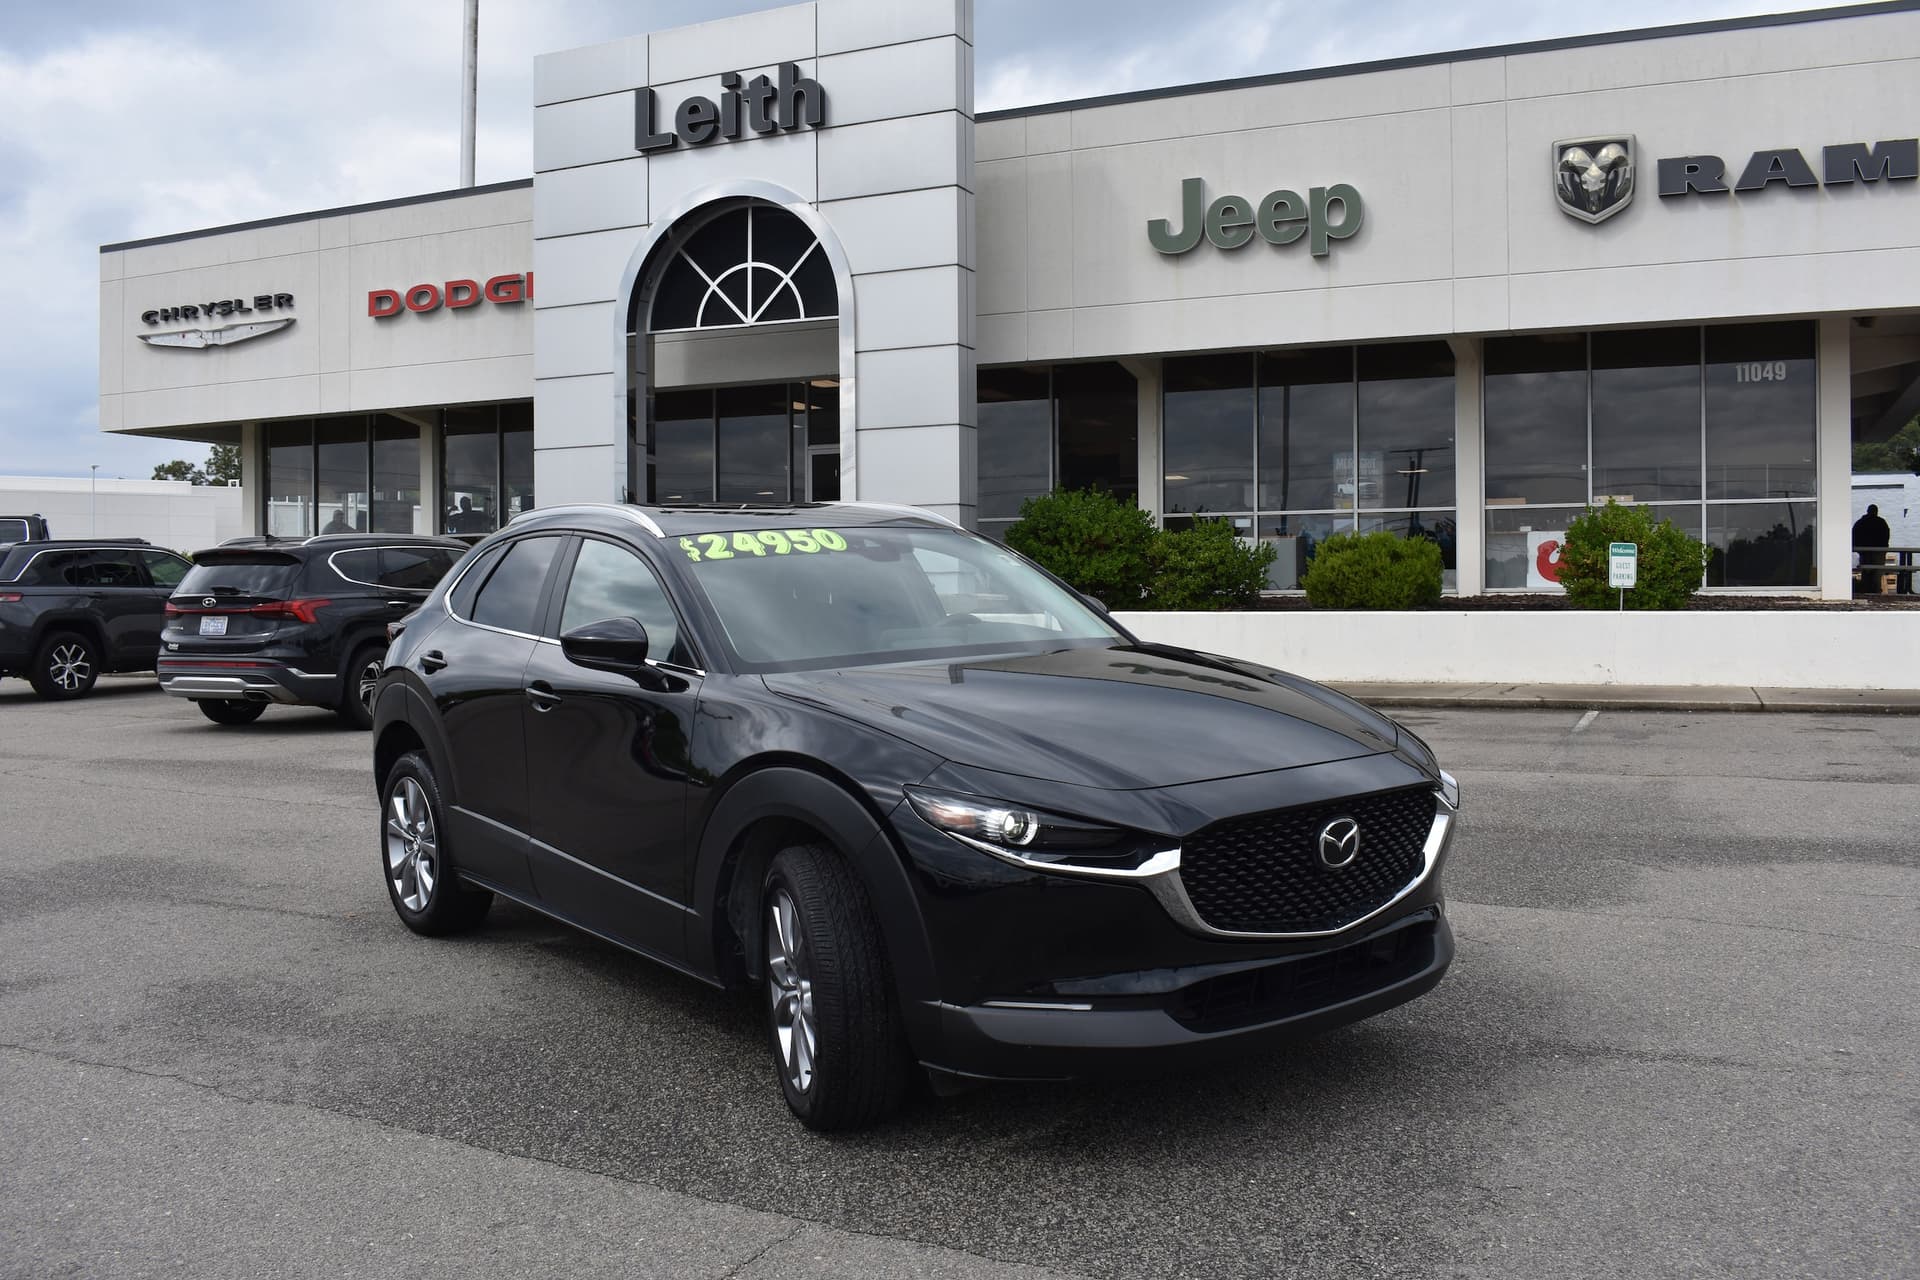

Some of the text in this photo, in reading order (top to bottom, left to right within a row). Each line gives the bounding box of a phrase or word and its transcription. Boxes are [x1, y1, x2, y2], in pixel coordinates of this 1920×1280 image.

[635, 62, 826, 153] Leith
[1657, 138, 1919, 198] RAM
[1147, 177, 1364, 256] Jeep
[141, 293, 294, 325] CHRYSLER
[1735, 361, 1786, 383] 11049
[679, 528, 848, 562] $24950
